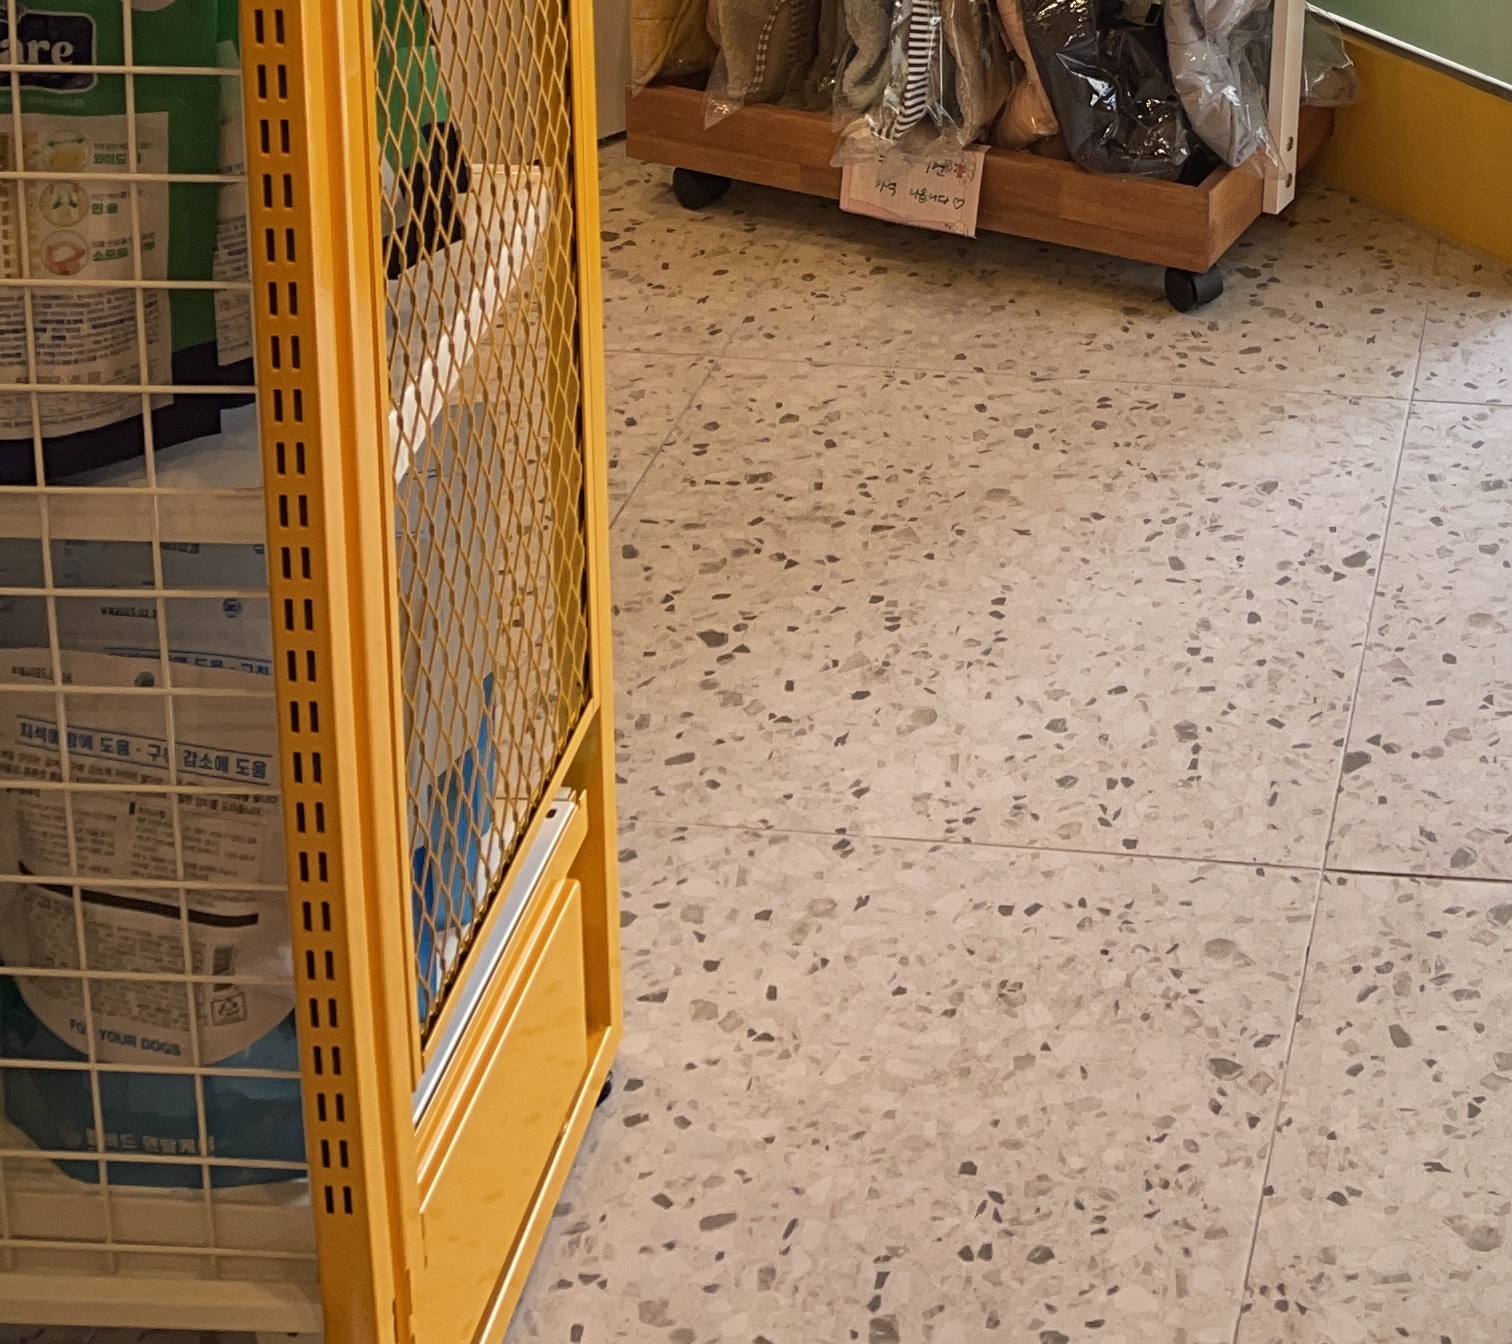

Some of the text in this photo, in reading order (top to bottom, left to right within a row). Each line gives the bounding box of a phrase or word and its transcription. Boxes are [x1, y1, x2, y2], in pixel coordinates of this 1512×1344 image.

[100, 736, 130, 757] 도움
[183, 749, 229, 775] 감소에
[235, 758, 268, 780] 도움
[98, 1029, 138, 1048] YOUR
[140, 1038, 182, 1056] DOGS
